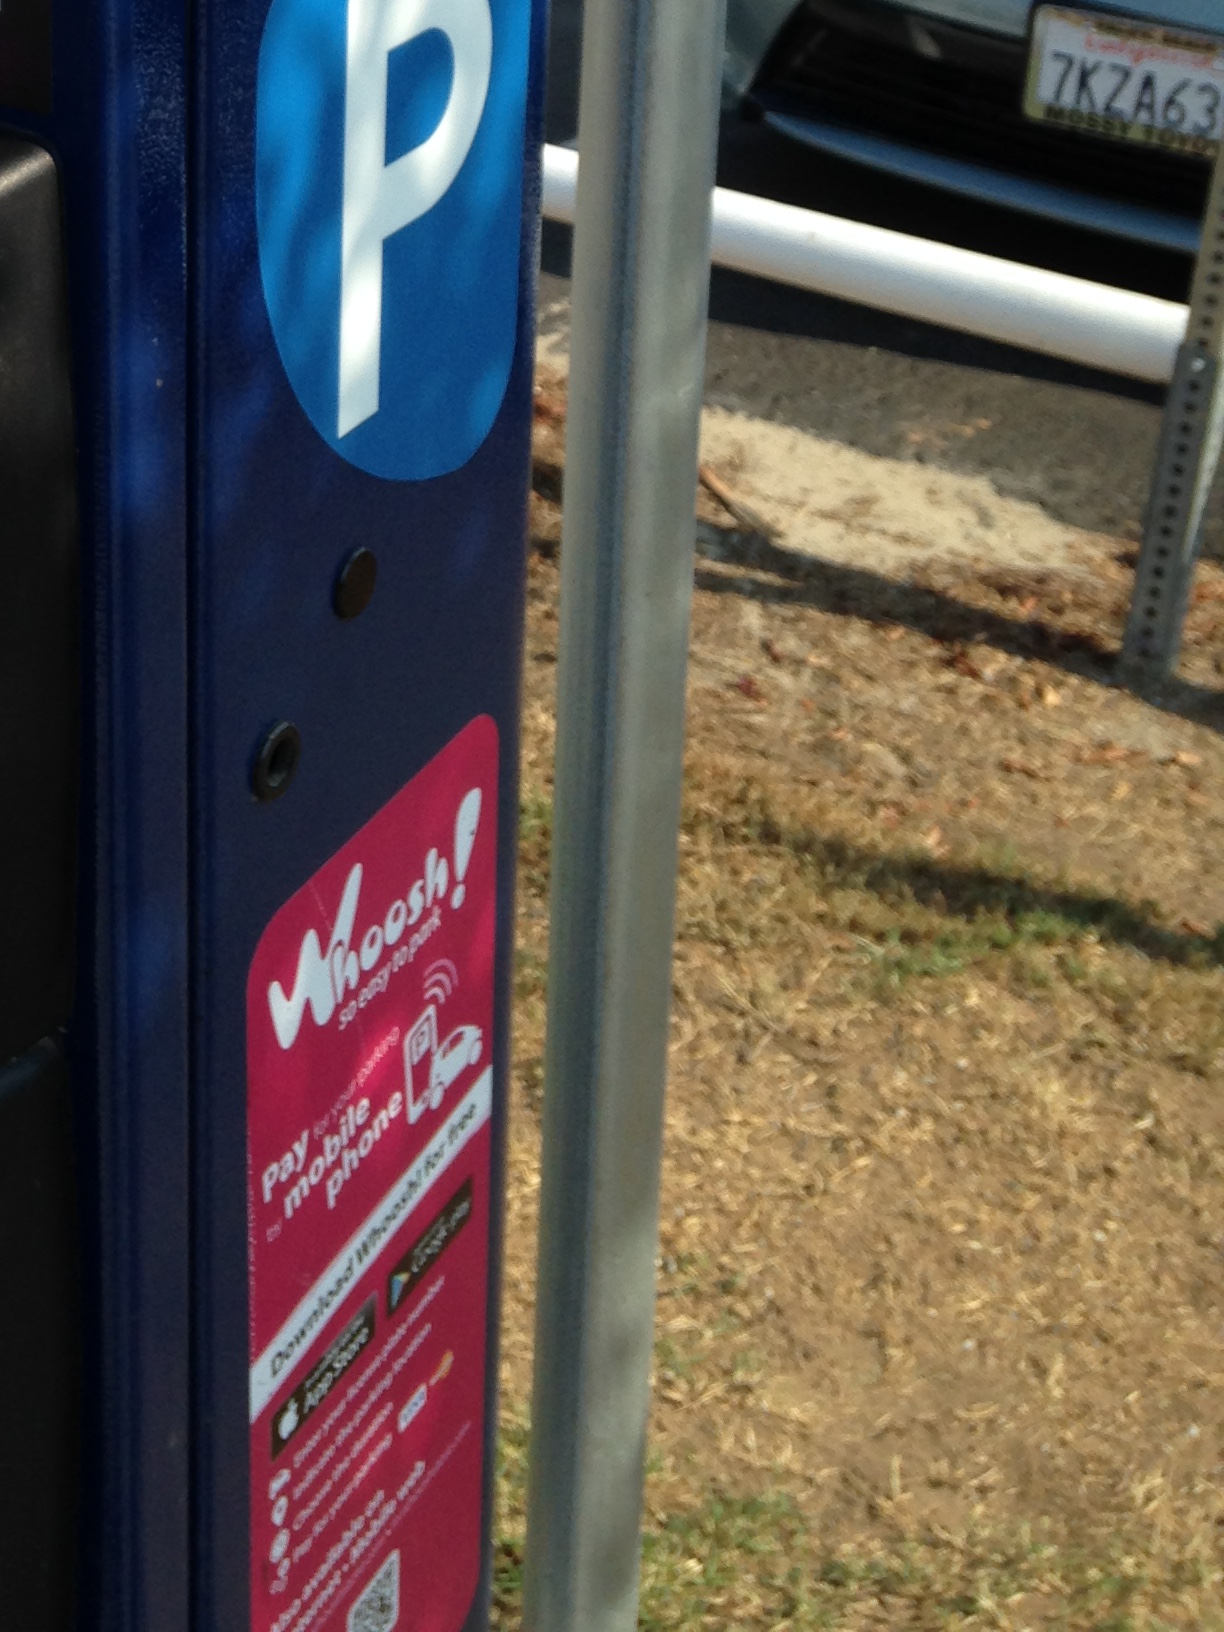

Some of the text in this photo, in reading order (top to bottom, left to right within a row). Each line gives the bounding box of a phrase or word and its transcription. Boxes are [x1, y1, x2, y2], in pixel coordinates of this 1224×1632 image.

[267, 787, 482, 1050] Whoosh!
[357, 966, 390, 1008] easy
[407, 905, 442, 961] park
[262, 1131, 308, 1202] Pay
[285, 1098, 370, 1218] mobile
[327, 1092, 402, 1208] phone
[271, 1258, 353, 1378] Download
[356, 1170, 421, 1264] Whoosh!
